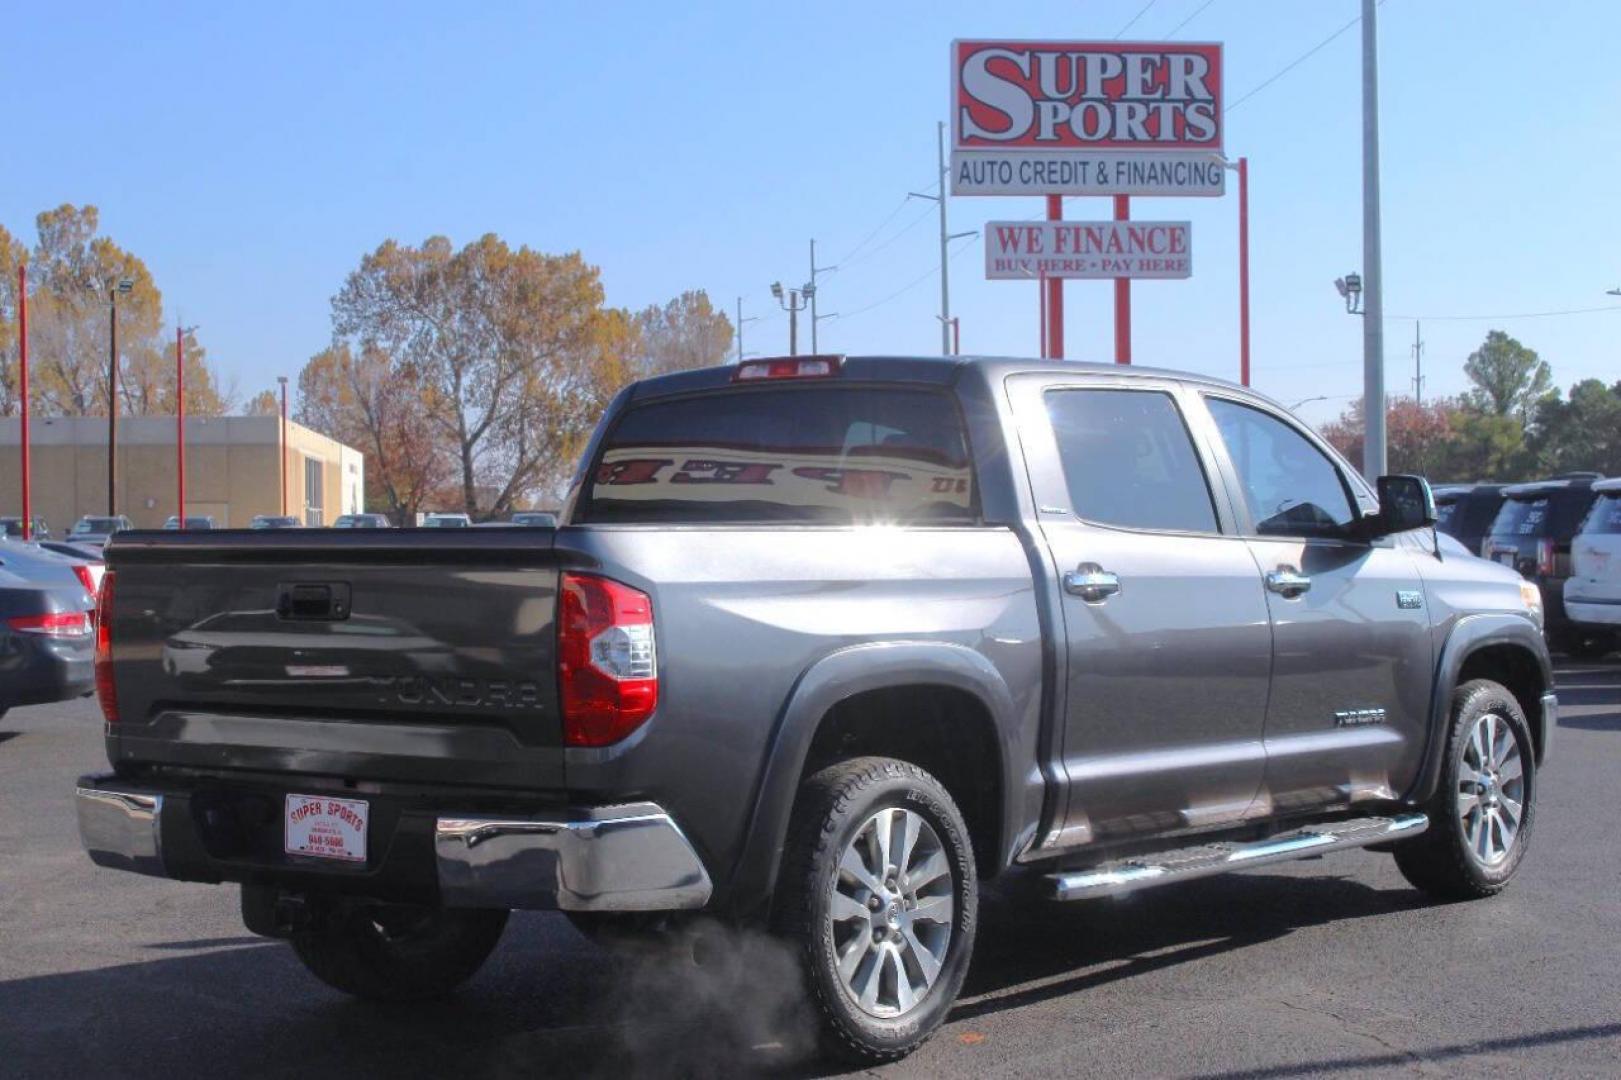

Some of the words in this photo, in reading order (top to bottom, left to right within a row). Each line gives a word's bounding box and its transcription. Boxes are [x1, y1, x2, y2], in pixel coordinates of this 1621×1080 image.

[960, 47, 1214, 142] SUPER
[959, 160, 1012, 185] AUTO
[1019, 160, 1089, 185] CREDIT
[1096, 160, 1109, 185] &
[1116, 161, 1221, 186] FINANCING
[995, 226, 1044, 254] WE
[1053, 226, 1186, 254] FINANCE
[995, 258, 1032, 271] BUY
[1037, 259, 1085, 271] HERE
[1101, 259, 1136, 271] PAY
[1139, 259, 1188, 272] HERE
[369, 676, 544, 709] TUNDRA
[290, 801, 322, 825] SUPER
[327, 802, 364, 833] SPORTS
